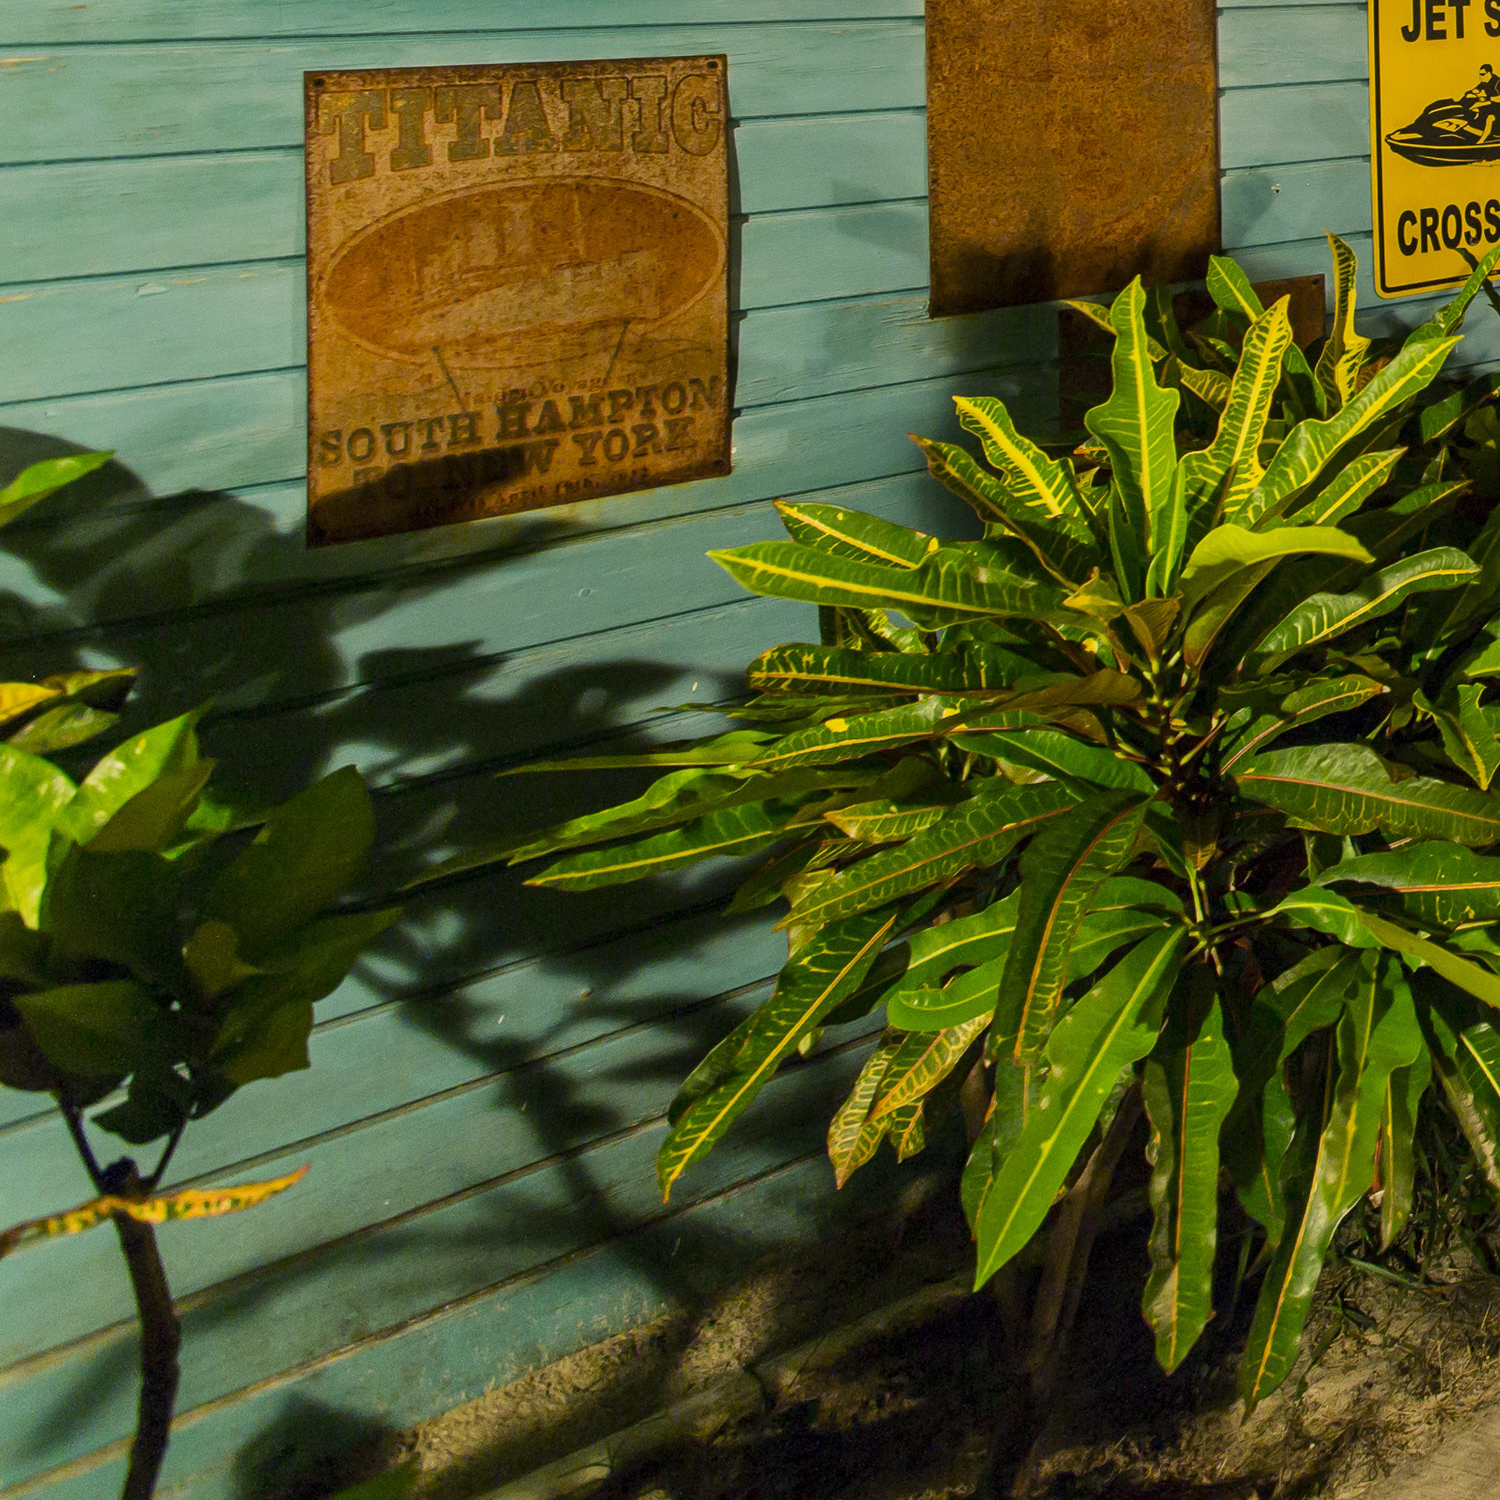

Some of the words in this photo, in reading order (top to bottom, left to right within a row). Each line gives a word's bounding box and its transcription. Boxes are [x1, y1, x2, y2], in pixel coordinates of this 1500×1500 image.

[318, 74, 723, 186] TITANIC
[317, 411, 483, 469] SOUTH
[494, 375, 721, 441] HAMPTON
[572, 416, 698, 466] YORK
